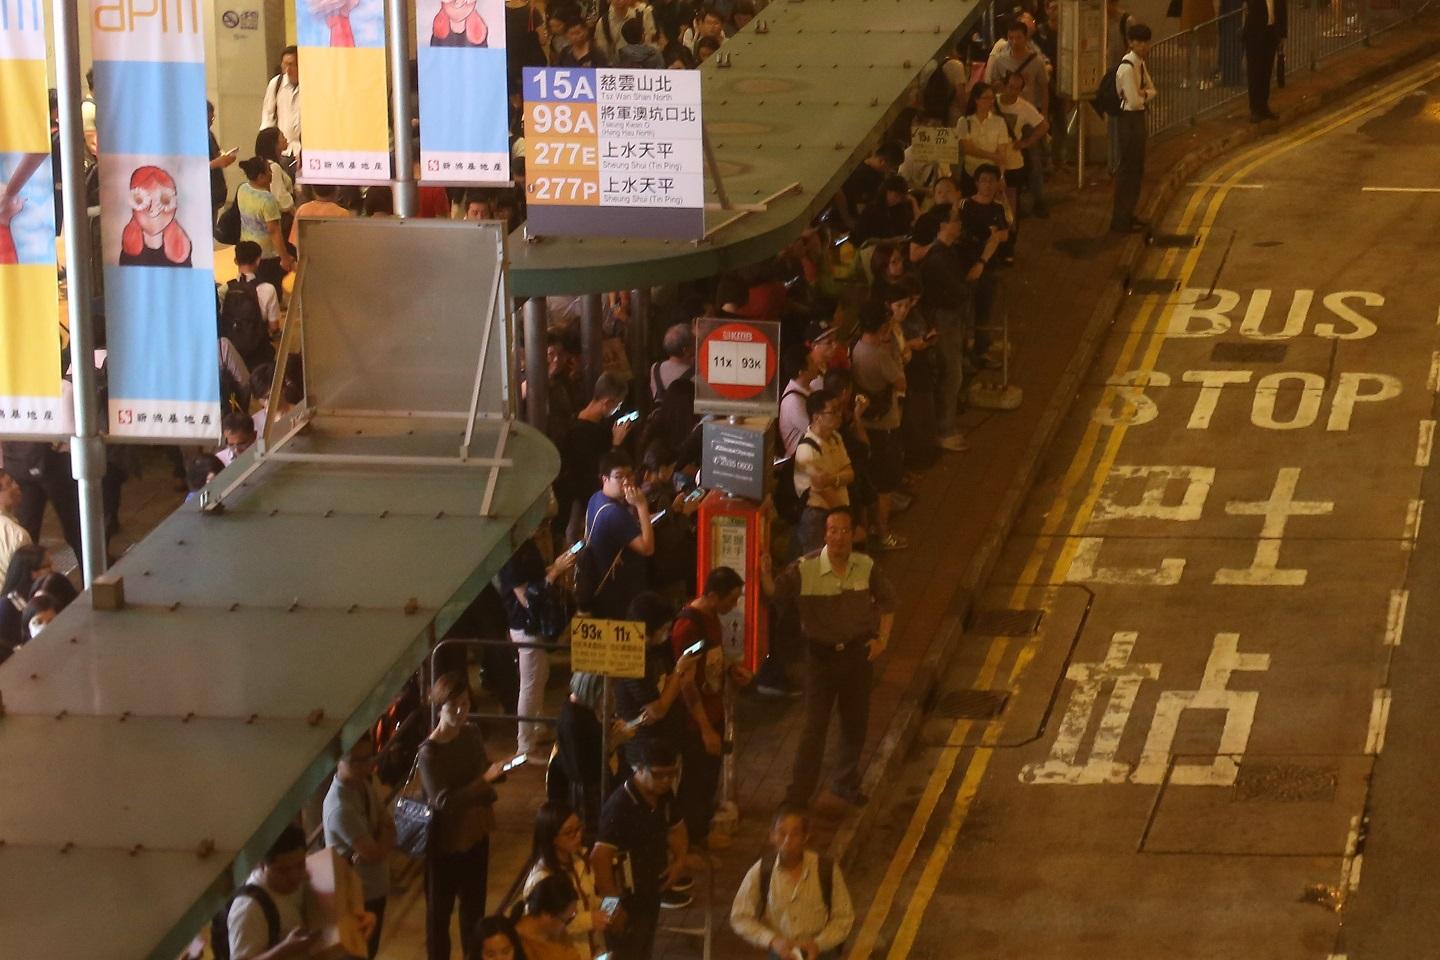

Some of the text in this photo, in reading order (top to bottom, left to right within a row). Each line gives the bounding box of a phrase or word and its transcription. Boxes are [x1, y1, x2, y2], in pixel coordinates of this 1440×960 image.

[532, 69, 595, 100] 15A
[600, 74, 673, 93] 慈雲山北
[616, 93, 632, 101] Wan
[633, 93, 650, 101] Shan
[532, 104, 596, 134] 98A
[600, 105, 696, 122] 將軍澳坑口北
[534, 142, 597, 166] 277E
[602, 141, 674, 159] 上水天平
[602, 161, 630, 170] Sheung
[631, 161, 647, 170] Shui
[535, 176, 598, 200] 277P
[603, 176, 675, 194] 上水天平
[603, 194, 631, 204] Sheung
[632, 195, 648, 203] Shui
[1167, 287, 1386, 340] BUS
[1094, 369, 1402, 432] STOP
[1066, 465, 1335, 586] 巴士
[1017, 631, 1272, 787] 站
